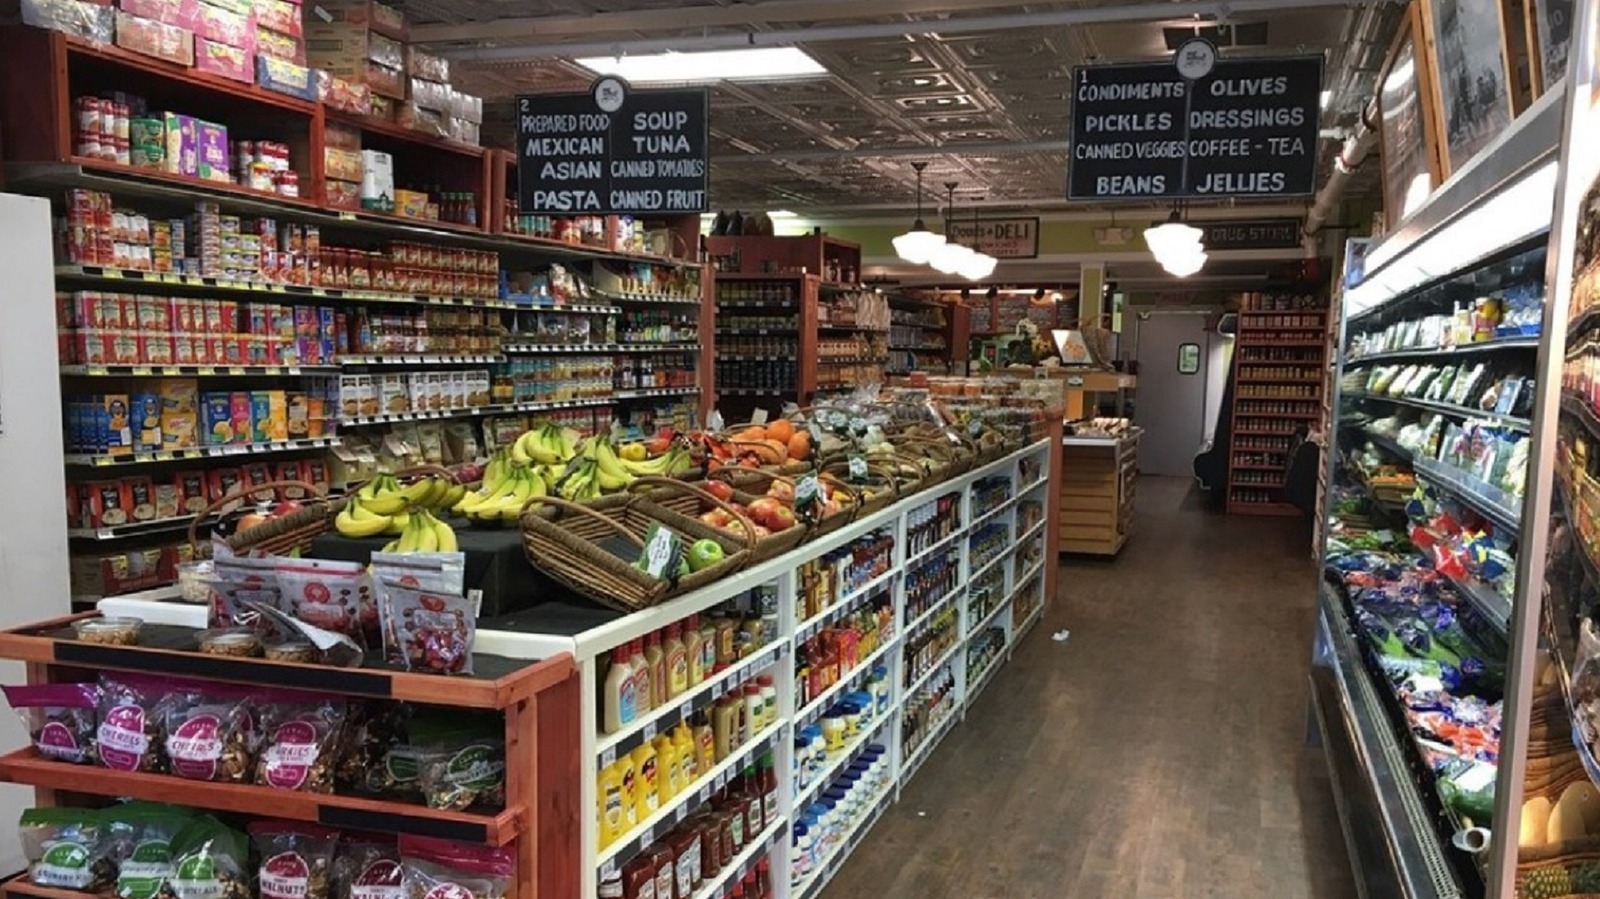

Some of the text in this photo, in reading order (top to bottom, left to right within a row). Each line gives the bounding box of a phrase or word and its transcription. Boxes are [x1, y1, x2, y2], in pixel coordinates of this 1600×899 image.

[1081, 70, 1088, 83] 1
[1078, 82, 1184, 102] CONDIMENTS
[1210, 77, 1288, 97] OLIVES
[520, 99, 530, 112] 2
[521, 114, 611, 133] PREPARED FOOD
[633, 112, 688, 131] SOUP
[1085, 113, 1172, 132] PICKLES
[1190, 107, 1305, 129] DRESSINGS
[525, 137, 604, 157] MEXICAN
[632, 135, 691, 154] TUNA
[1076, 140, 1186, 160] CANNED VEGGIES
[1189, 138, 1251, 157] COFFEE
[1267, 137, 1305, 156] TEA
[540, 161, 602, 180] ASIAN
[610, 158, 705, 178] CANNED TOMATOES
[1096, 175, 1166, 195] BEANS
[1195, 172, 1286, 193] JELLIES
[533, 190, 601, 210] PASTA
[610, 190, 705, 209] CANNED FRUIT
[995, 224, 1028, 239] DELI
